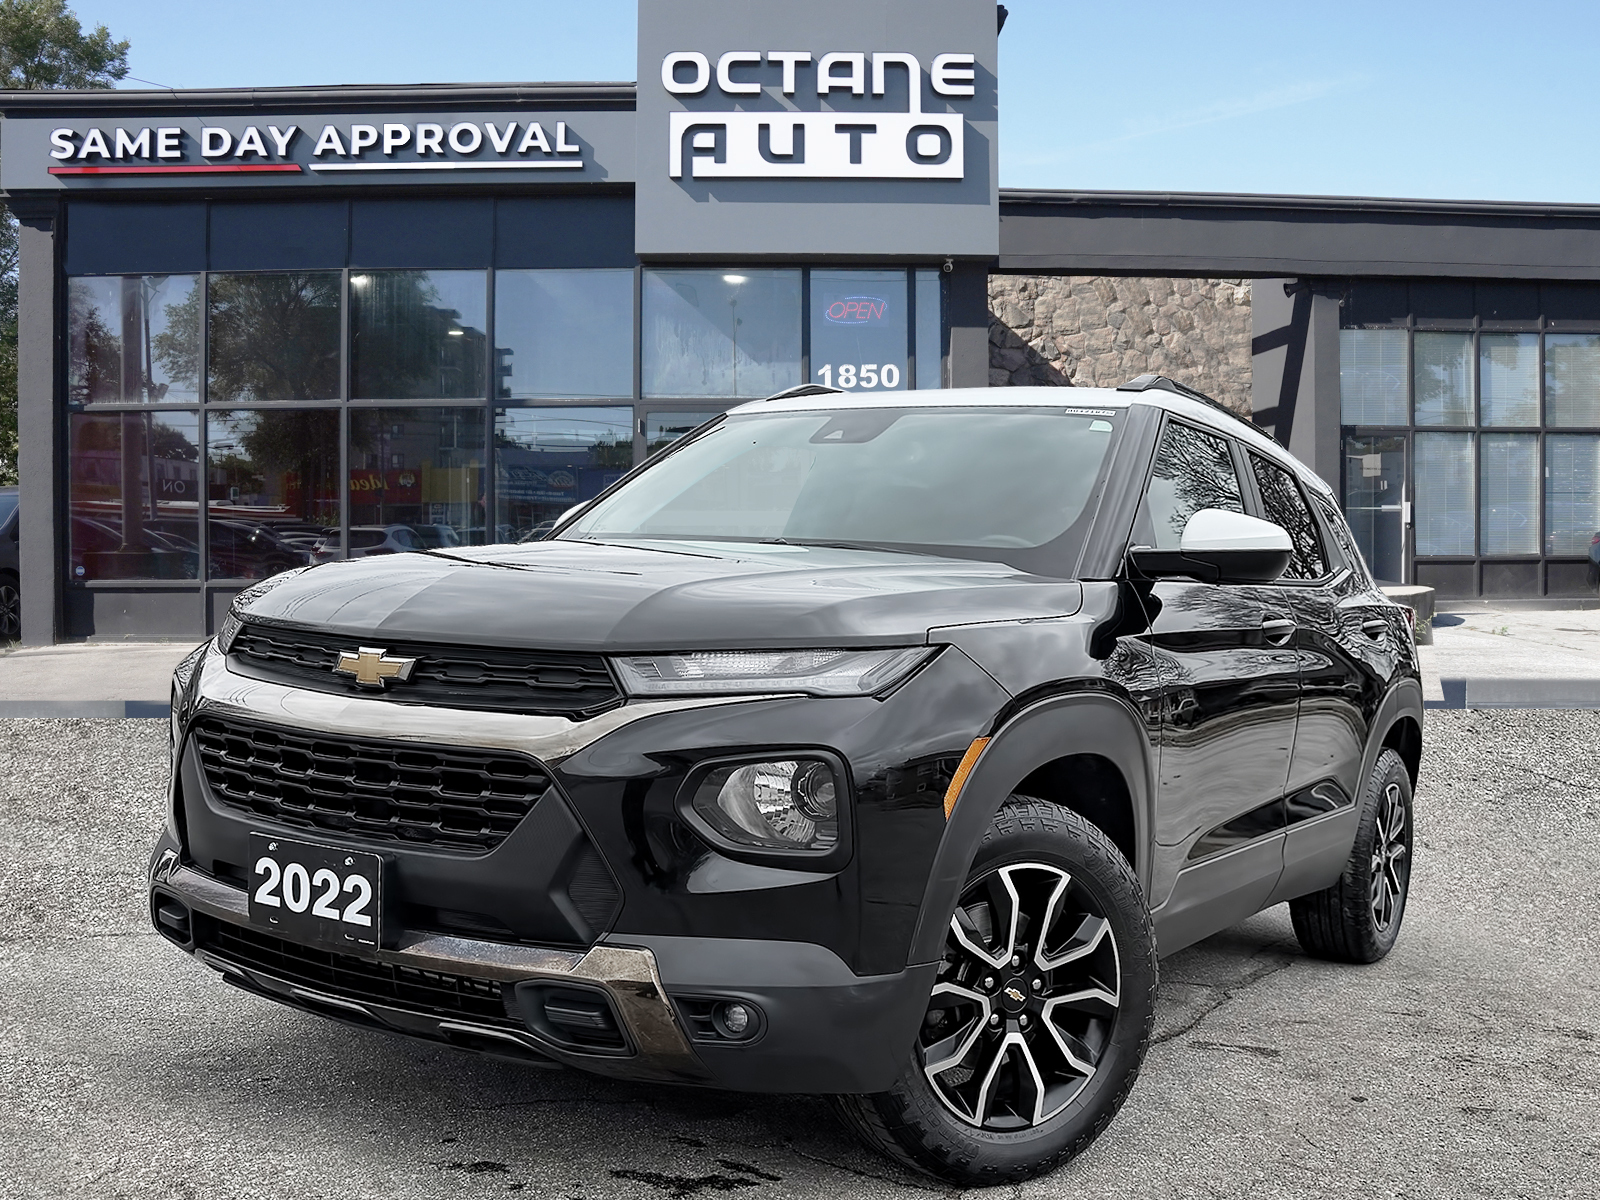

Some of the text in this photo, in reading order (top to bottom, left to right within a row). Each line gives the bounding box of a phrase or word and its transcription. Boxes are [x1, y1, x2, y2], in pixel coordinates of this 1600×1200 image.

[660, 50, 975, 112] OCTANE
[49, 121, 580, 160] SAME DAY APPROVAL
[678, 121, 955, 177] AUTO
[829, 301, 885, 319] OPEN
[818, 364, 900, 388] 1850
[254, 856, 372, 927] 2022
